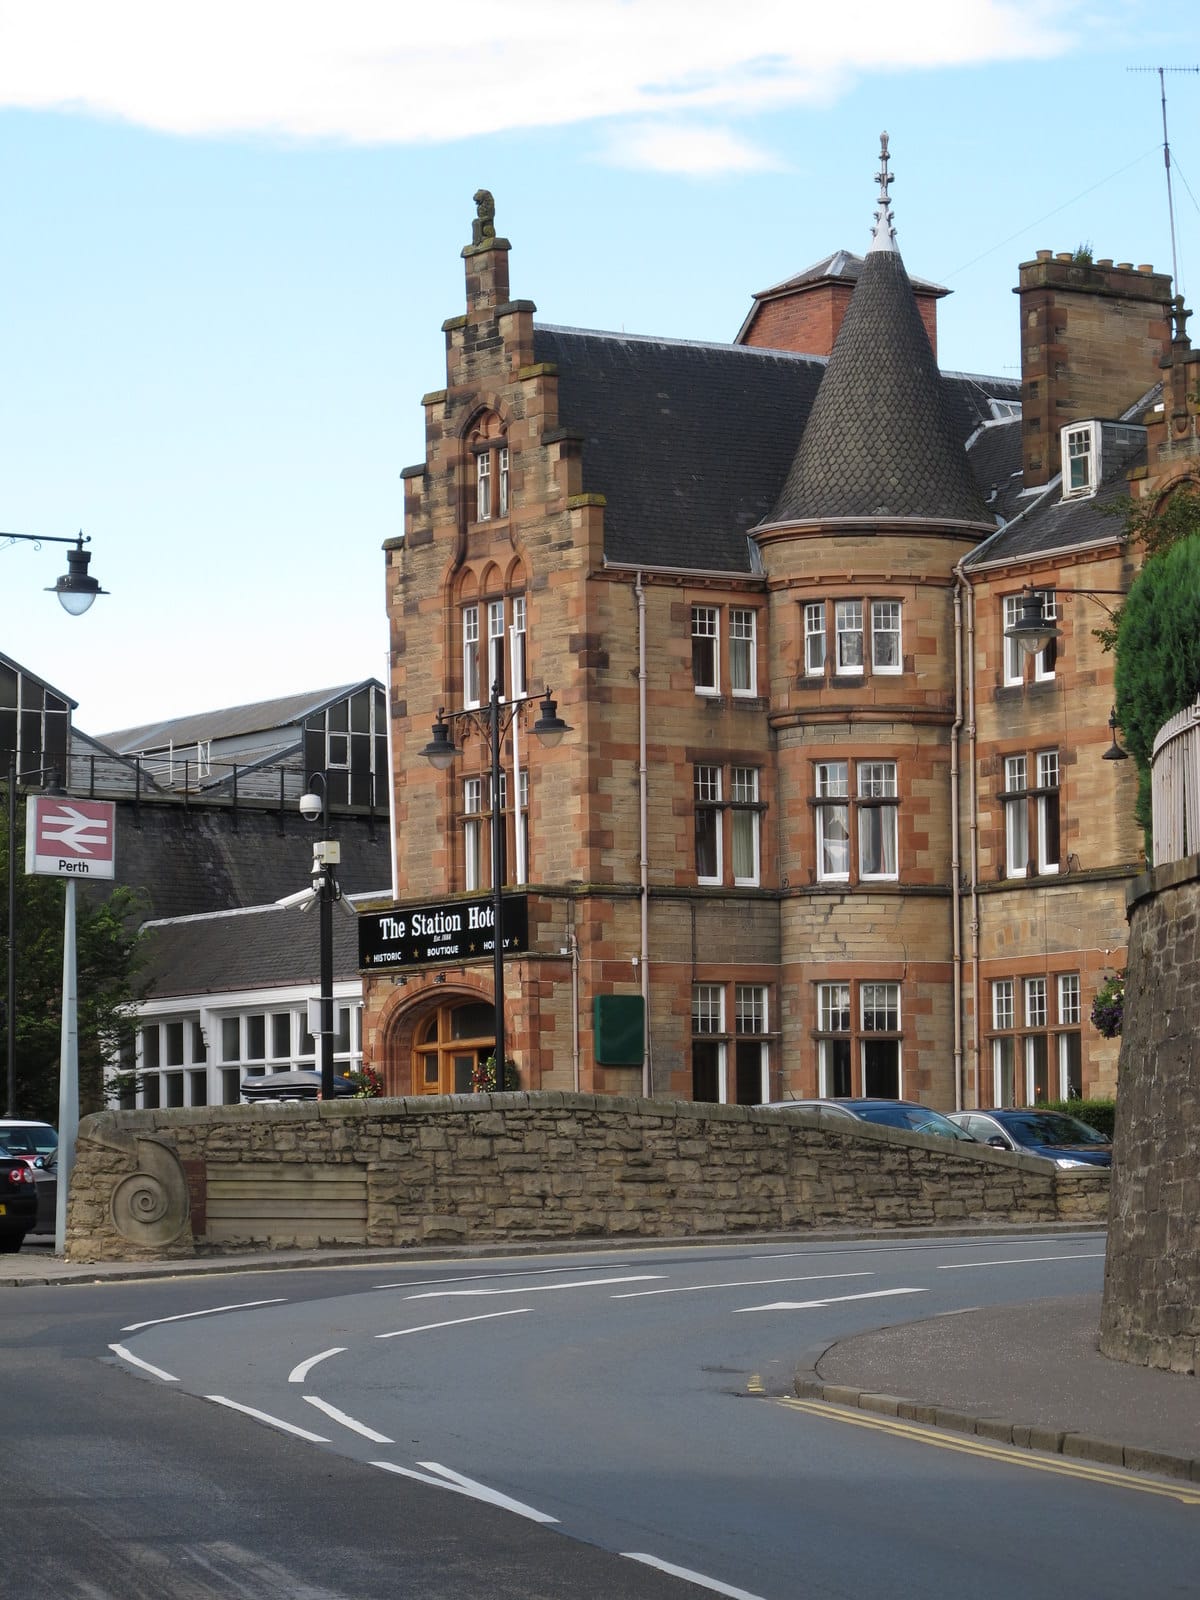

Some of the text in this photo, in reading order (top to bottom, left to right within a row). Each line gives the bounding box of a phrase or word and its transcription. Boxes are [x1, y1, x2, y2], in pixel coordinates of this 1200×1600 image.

[59, 860, 89, 872] Perth
[380, 918, 405, 940] The
[412, 911, 461, 936] Station
[374, 952, 401, 962] HISTORIC
[427, 945, 459, 956] BOUTIQUE
